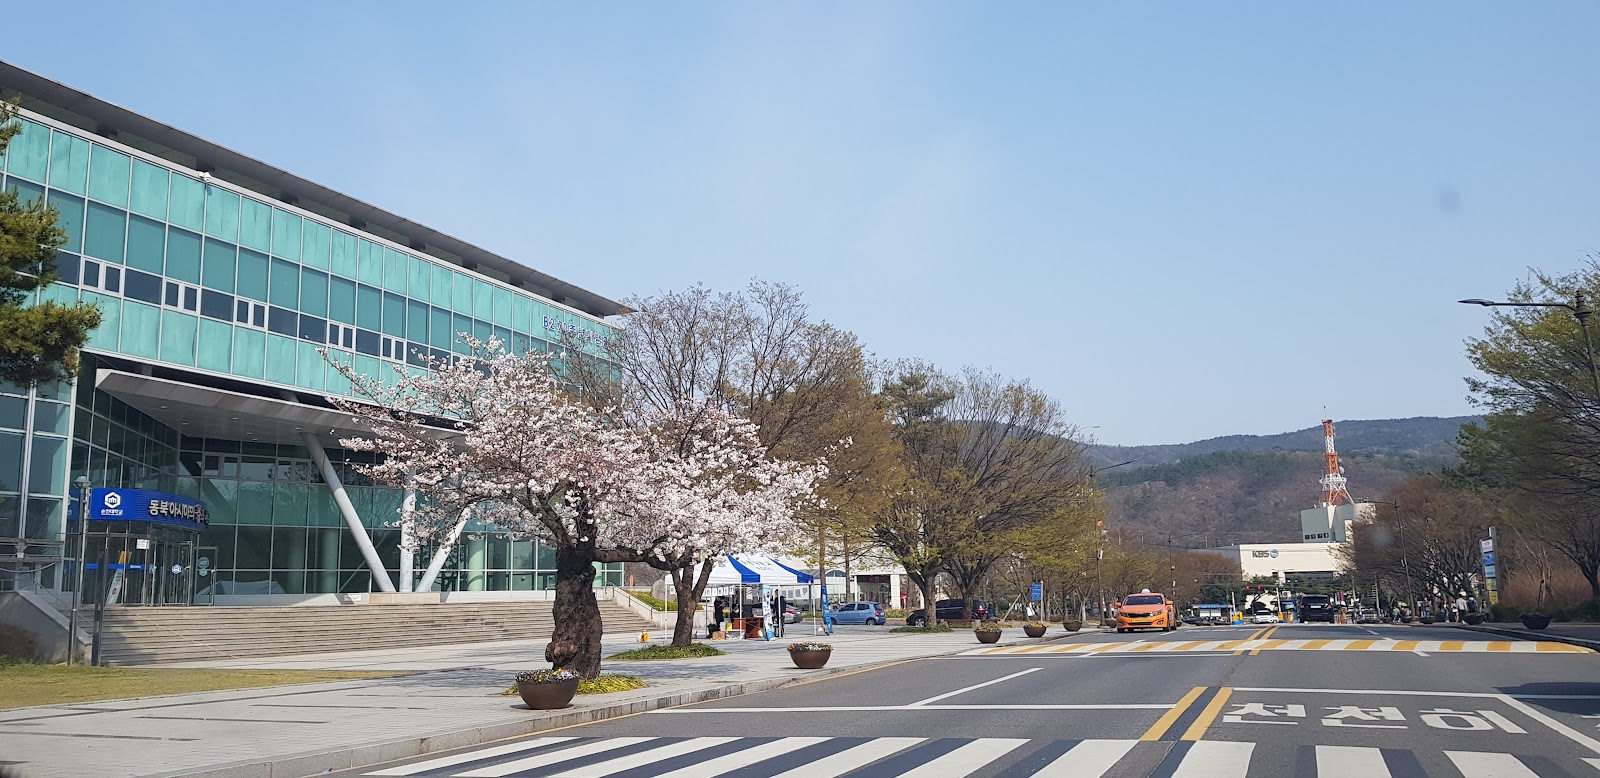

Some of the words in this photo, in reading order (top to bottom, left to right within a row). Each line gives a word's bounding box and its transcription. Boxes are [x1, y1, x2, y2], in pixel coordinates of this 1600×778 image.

[543, 315, 556, 331] B2
[149, 500, 195, 520] 동북아시아의
[1252, 550, 1270, 558] KBS
[1222, 702, 1528, 734] 천천히
